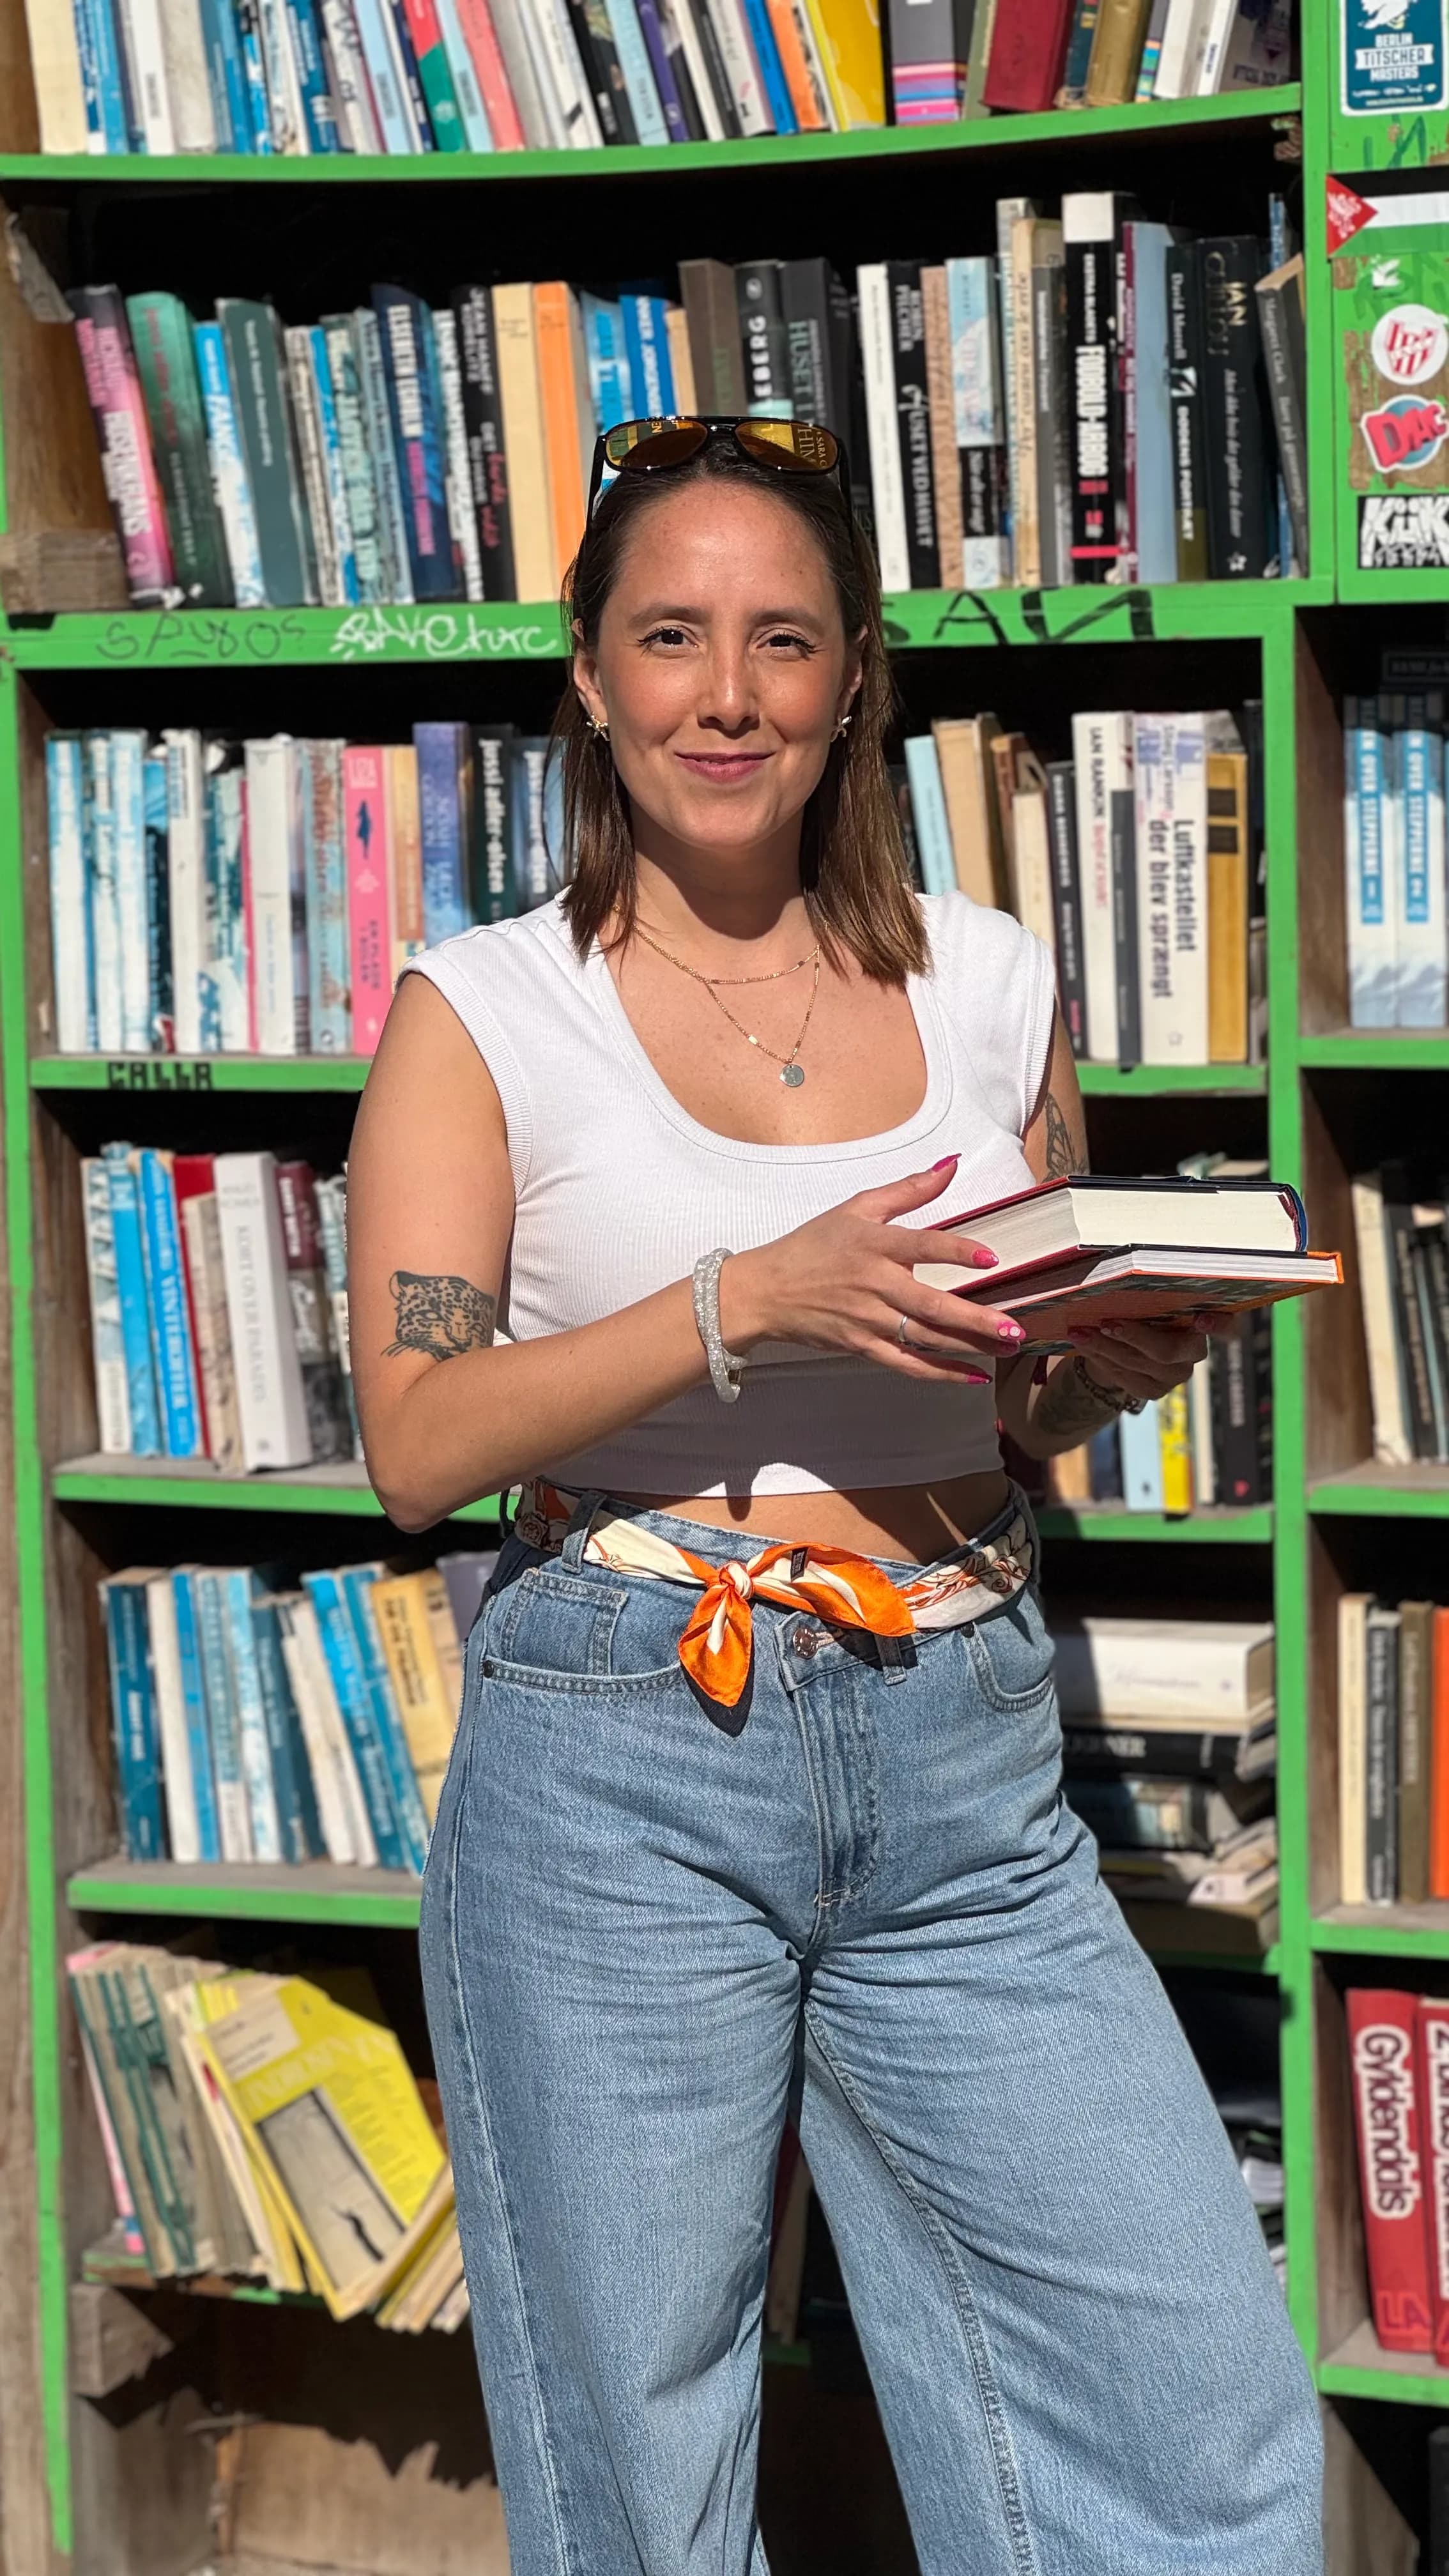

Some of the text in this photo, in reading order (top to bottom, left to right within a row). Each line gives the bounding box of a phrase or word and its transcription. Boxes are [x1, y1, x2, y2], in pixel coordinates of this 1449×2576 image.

[1084, 253, 1097, 343] EKSTRA BLADETS
[1169, 272, 1186, 310] David
[789, 322, 814, 394] HUSET
[1271, 349, 1289, 384] Clark
[816, 436, 827, 458] SARA
[479, 737, 504, 785] jussi
[1089, 726, 1103, 753] IAN
[1160, 724, 1176, 755] Stieg
[1090, 757, 1107, 817] RANKIN
[1147, 818, 1173, 999] der blev sprængt
[1169, 818, 1200, 951] Luftkastellet
[1360, 2031, 1413, 2213] Gyldendals
